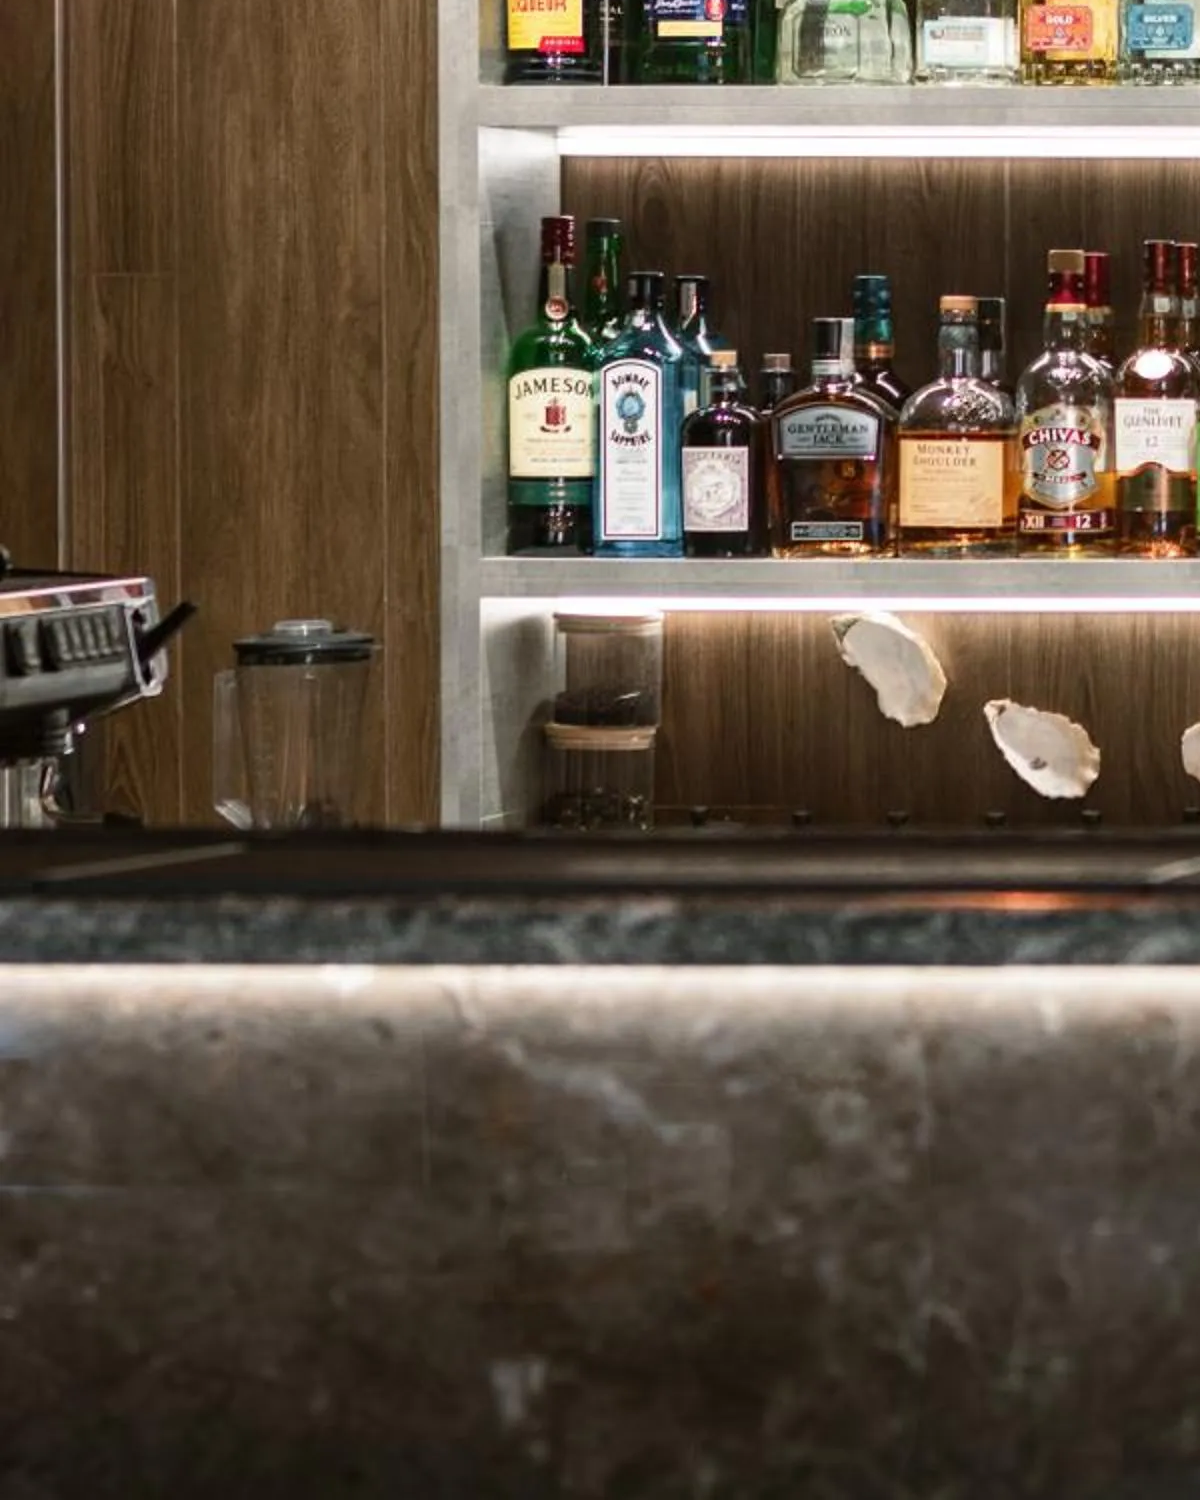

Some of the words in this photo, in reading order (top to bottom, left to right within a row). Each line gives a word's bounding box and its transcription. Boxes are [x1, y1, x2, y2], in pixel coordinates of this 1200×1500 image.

[611, 372, 650, 389] BOMBAY
[1028, 425, 1092, 445] CHIVAS
[1075, 513, 1091, 529] 12
